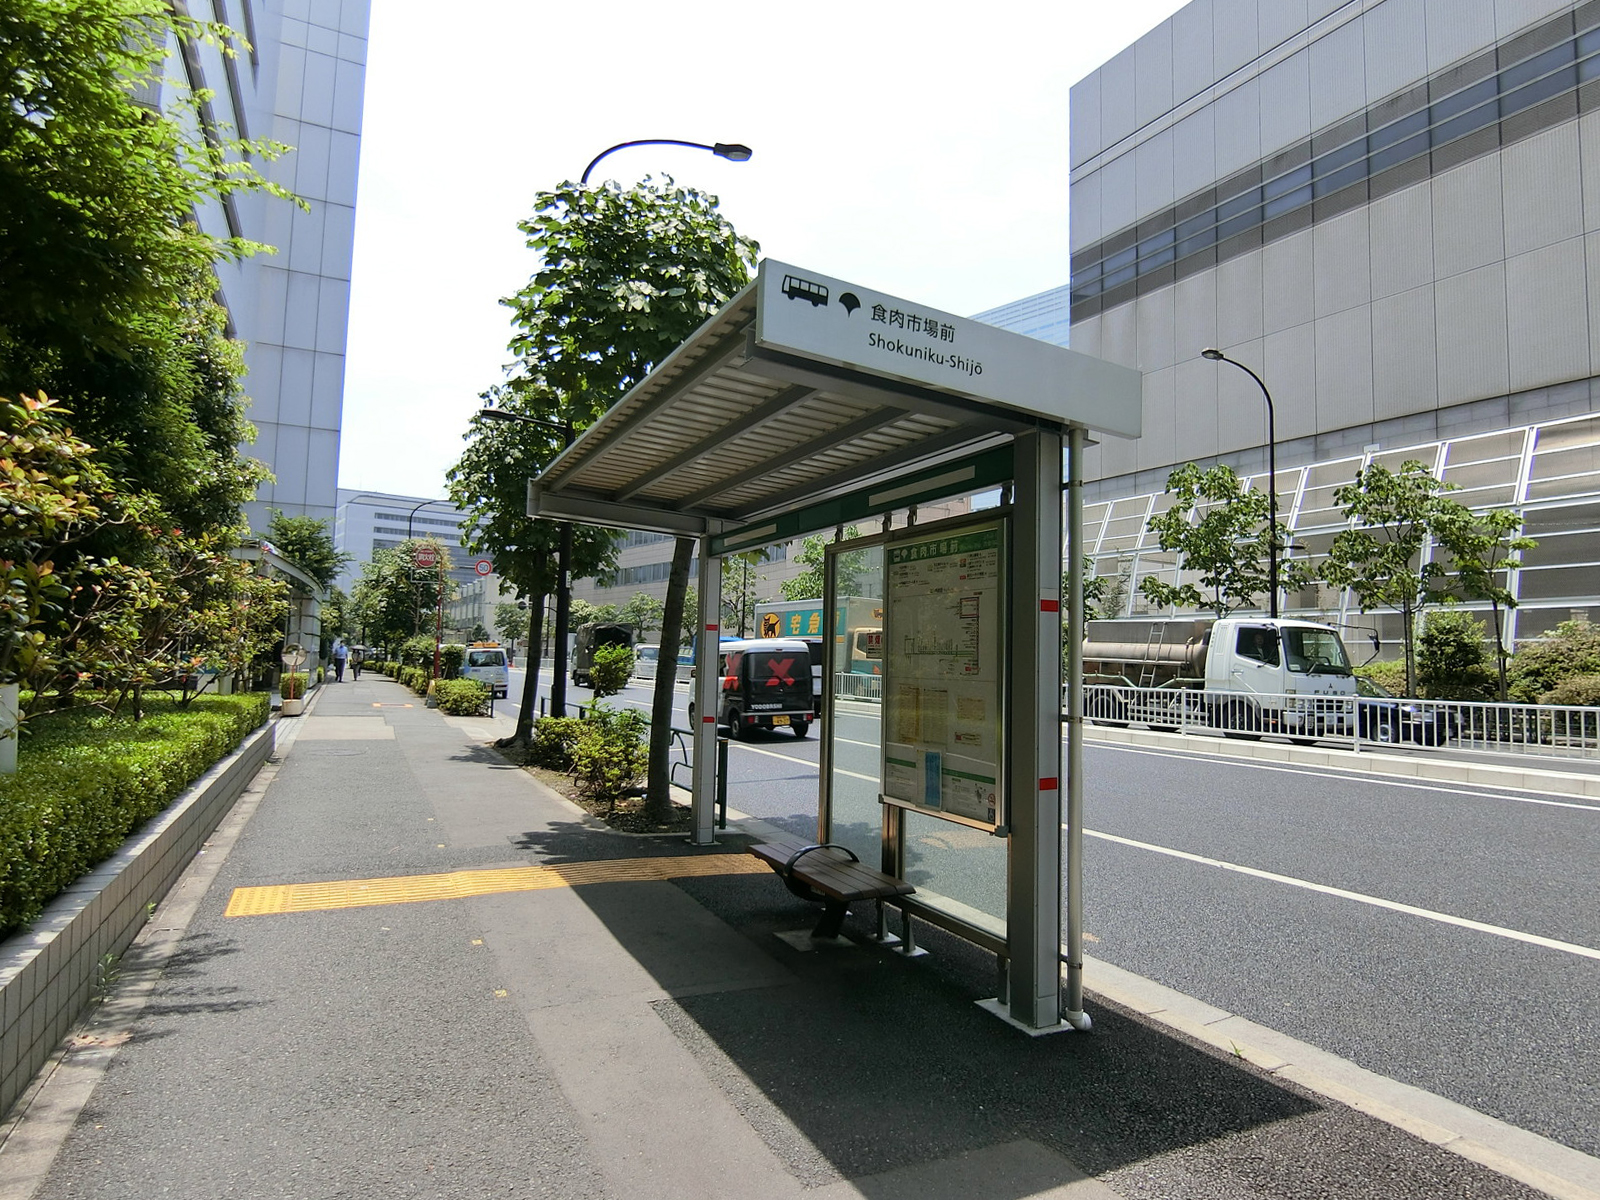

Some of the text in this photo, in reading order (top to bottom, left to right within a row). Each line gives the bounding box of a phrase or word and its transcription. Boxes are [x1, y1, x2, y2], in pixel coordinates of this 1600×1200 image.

[870, 304, 956, 344] 食肉市場前
[868, 332, 983, 377] Shokuniku-Shijō
[479, 564, 489, 572] 50
